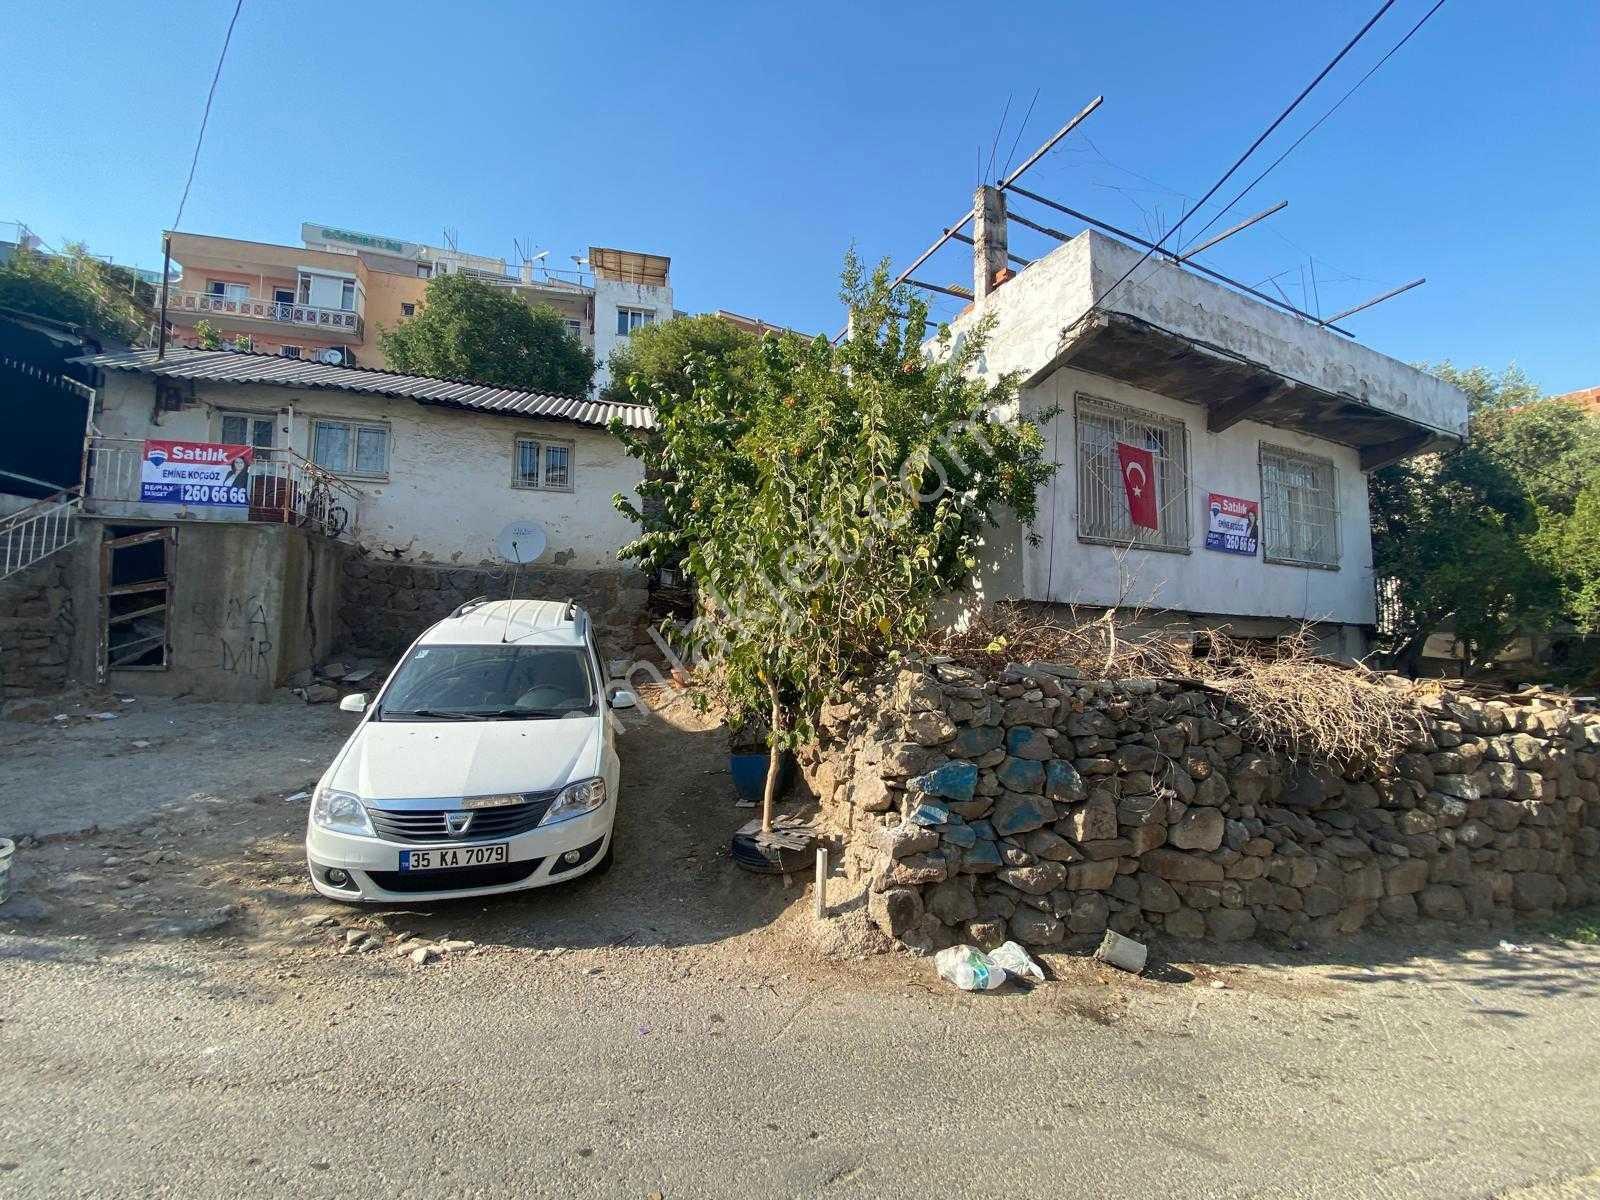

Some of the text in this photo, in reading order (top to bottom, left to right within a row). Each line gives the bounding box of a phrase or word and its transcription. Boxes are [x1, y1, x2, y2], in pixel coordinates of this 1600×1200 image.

[171, 446, 229, 463] Satılık
[184, 485, 210, 502] 260
[211, 486, 228, 503] 66
[229, 487, 246, 503] 66
[1226, 534, 1239, 550] 260
[411, 846, 504, 868] 35 KA 7079
